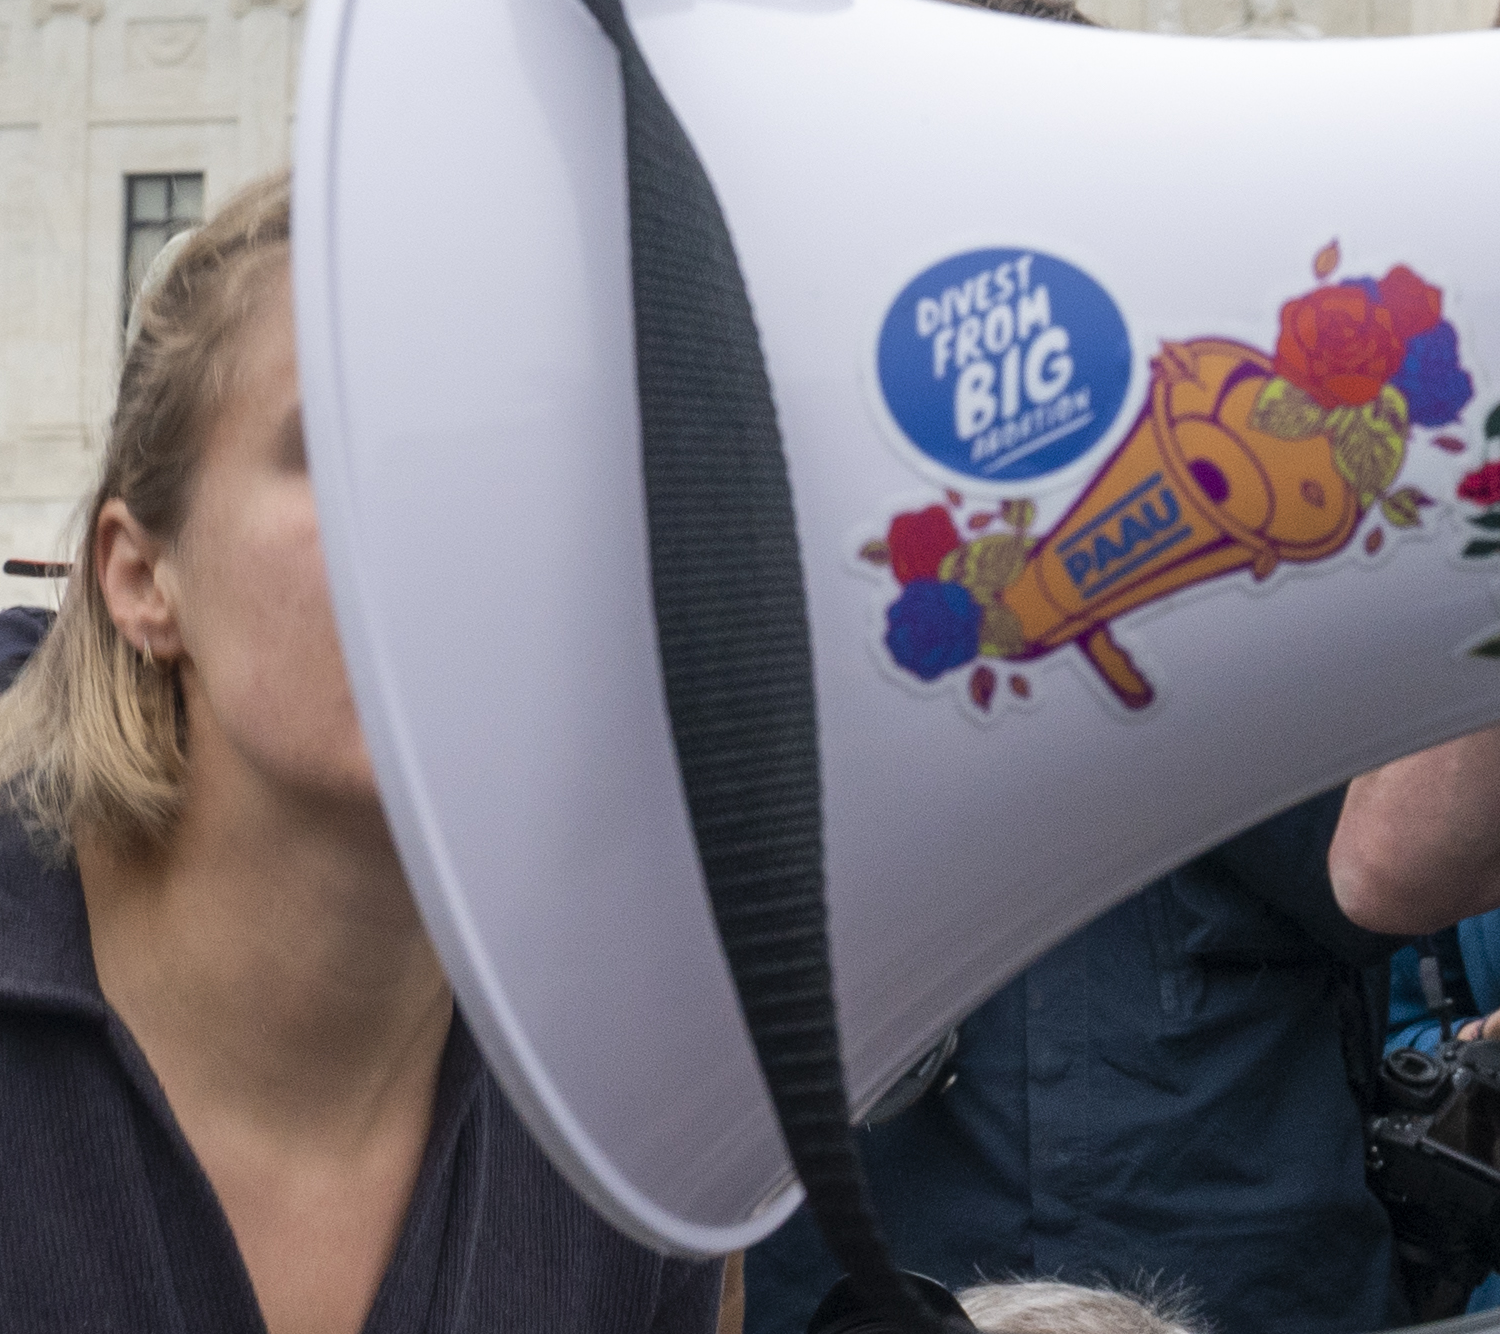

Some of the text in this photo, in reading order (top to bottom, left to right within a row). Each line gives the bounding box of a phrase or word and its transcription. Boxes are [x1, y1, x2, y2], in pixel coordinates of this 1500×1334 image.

[916, 254, 1033, 338] DIVEST
[933, 284, 1051, 380] FROM
[955, 325, 1074, 441] BIG
[1065, 488, 1181, 586] PAAU
